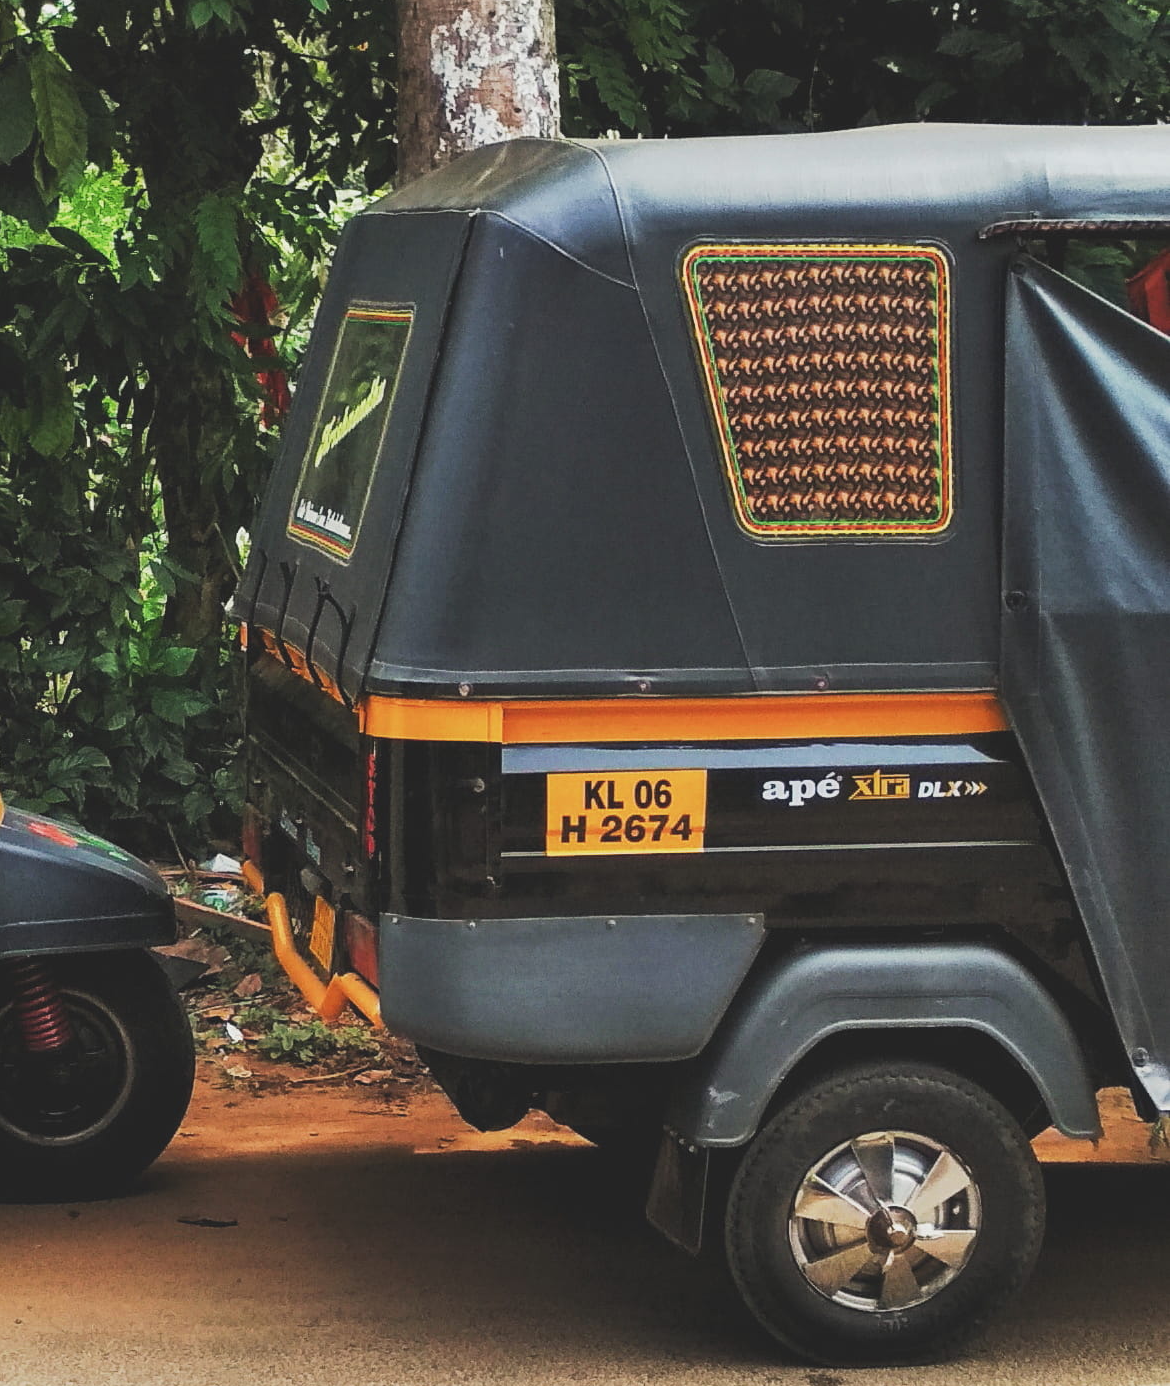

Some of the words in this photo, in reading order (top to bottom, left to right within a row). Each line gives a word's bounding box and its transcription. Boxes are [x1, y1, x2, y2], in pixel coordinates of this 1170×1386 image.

[584, 780, 624, 810] KL
[634, 779, 672, 809] 06
[918, 780, 962, 798] DLX
[561, 815, 587, 843] H
[600, 814, 692, 843] 2674
